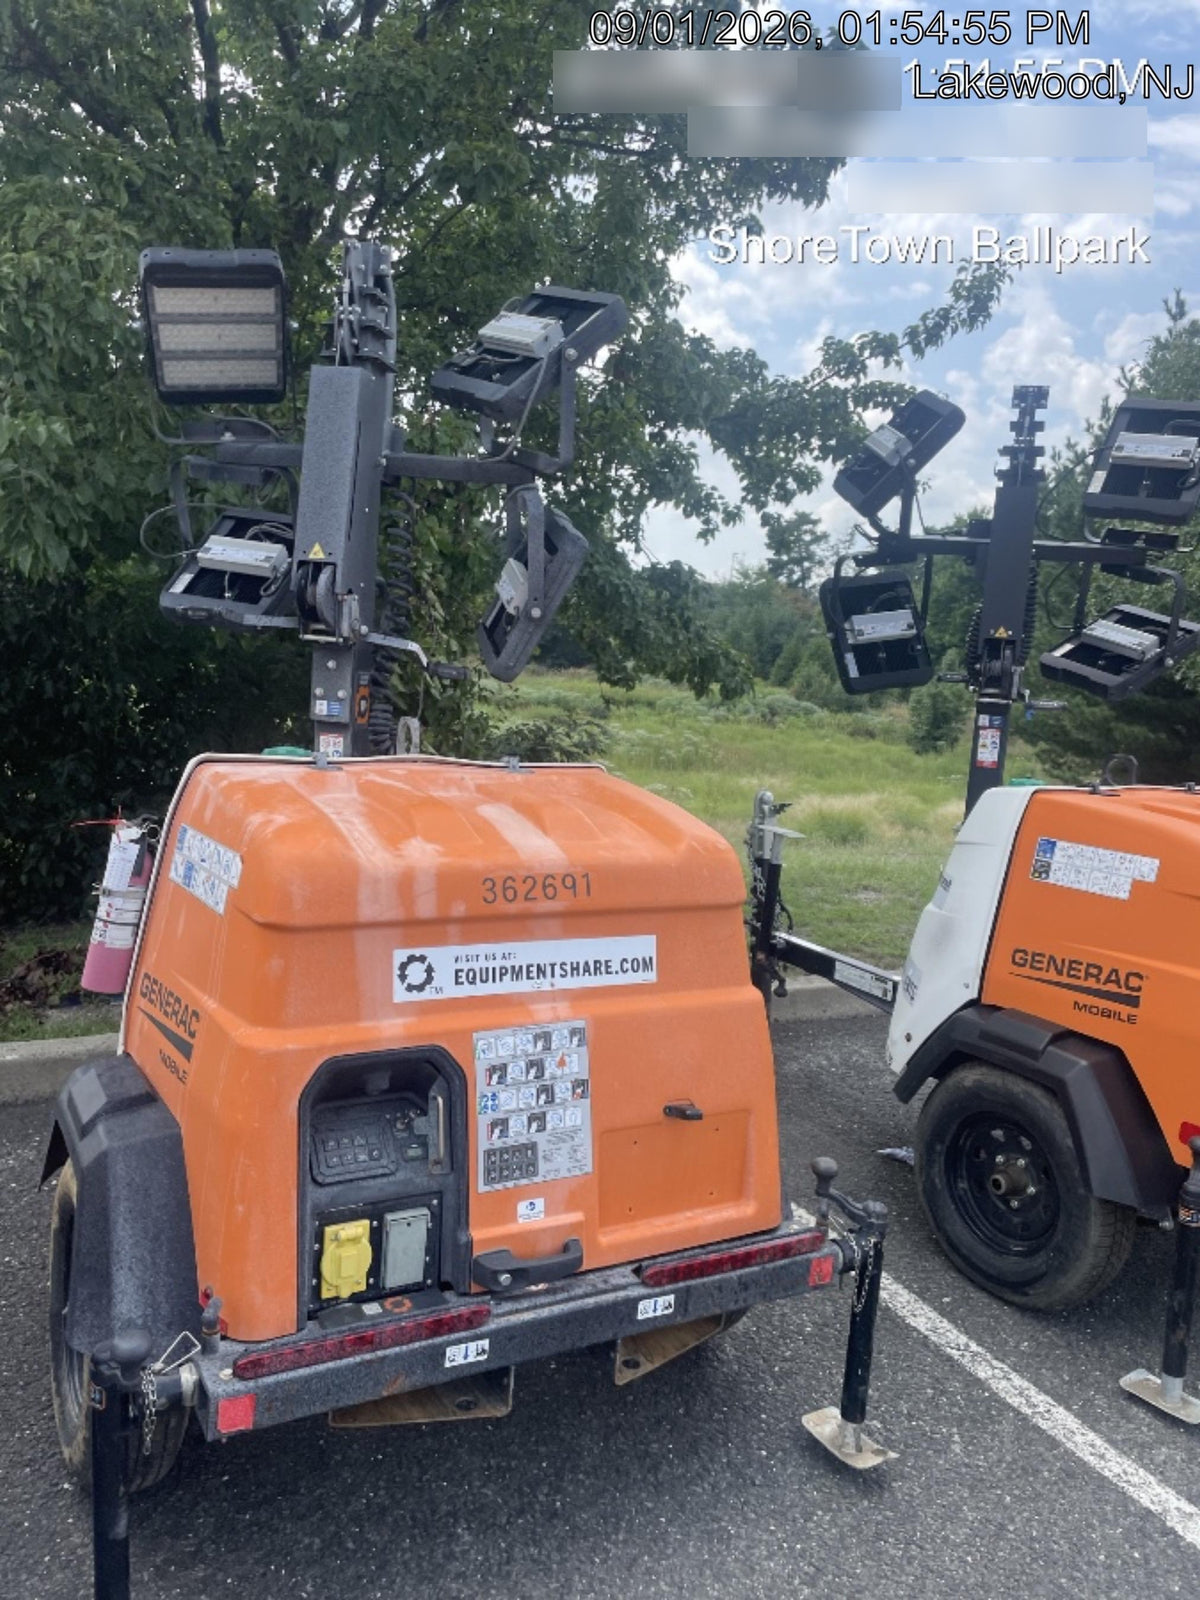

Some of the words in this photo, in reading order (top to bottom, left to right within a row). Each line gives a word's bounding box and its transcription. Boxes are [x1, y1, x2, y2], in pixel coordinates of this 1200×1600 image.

[481, 872, 593, 905] 362691
[453, 956, 655, 987] EQUIPMENTSHARE.COM
[454, 953, 481, 964] VISIT
[484, 952, 497, 963] US
[1011, 948, 1145, 992] GENERAC
[140, 972, 200, 1039] GENERAC
[1073, 1000, 1138, 1025] MOBILE
[159, 1048, 188, 1085] MOBILE
